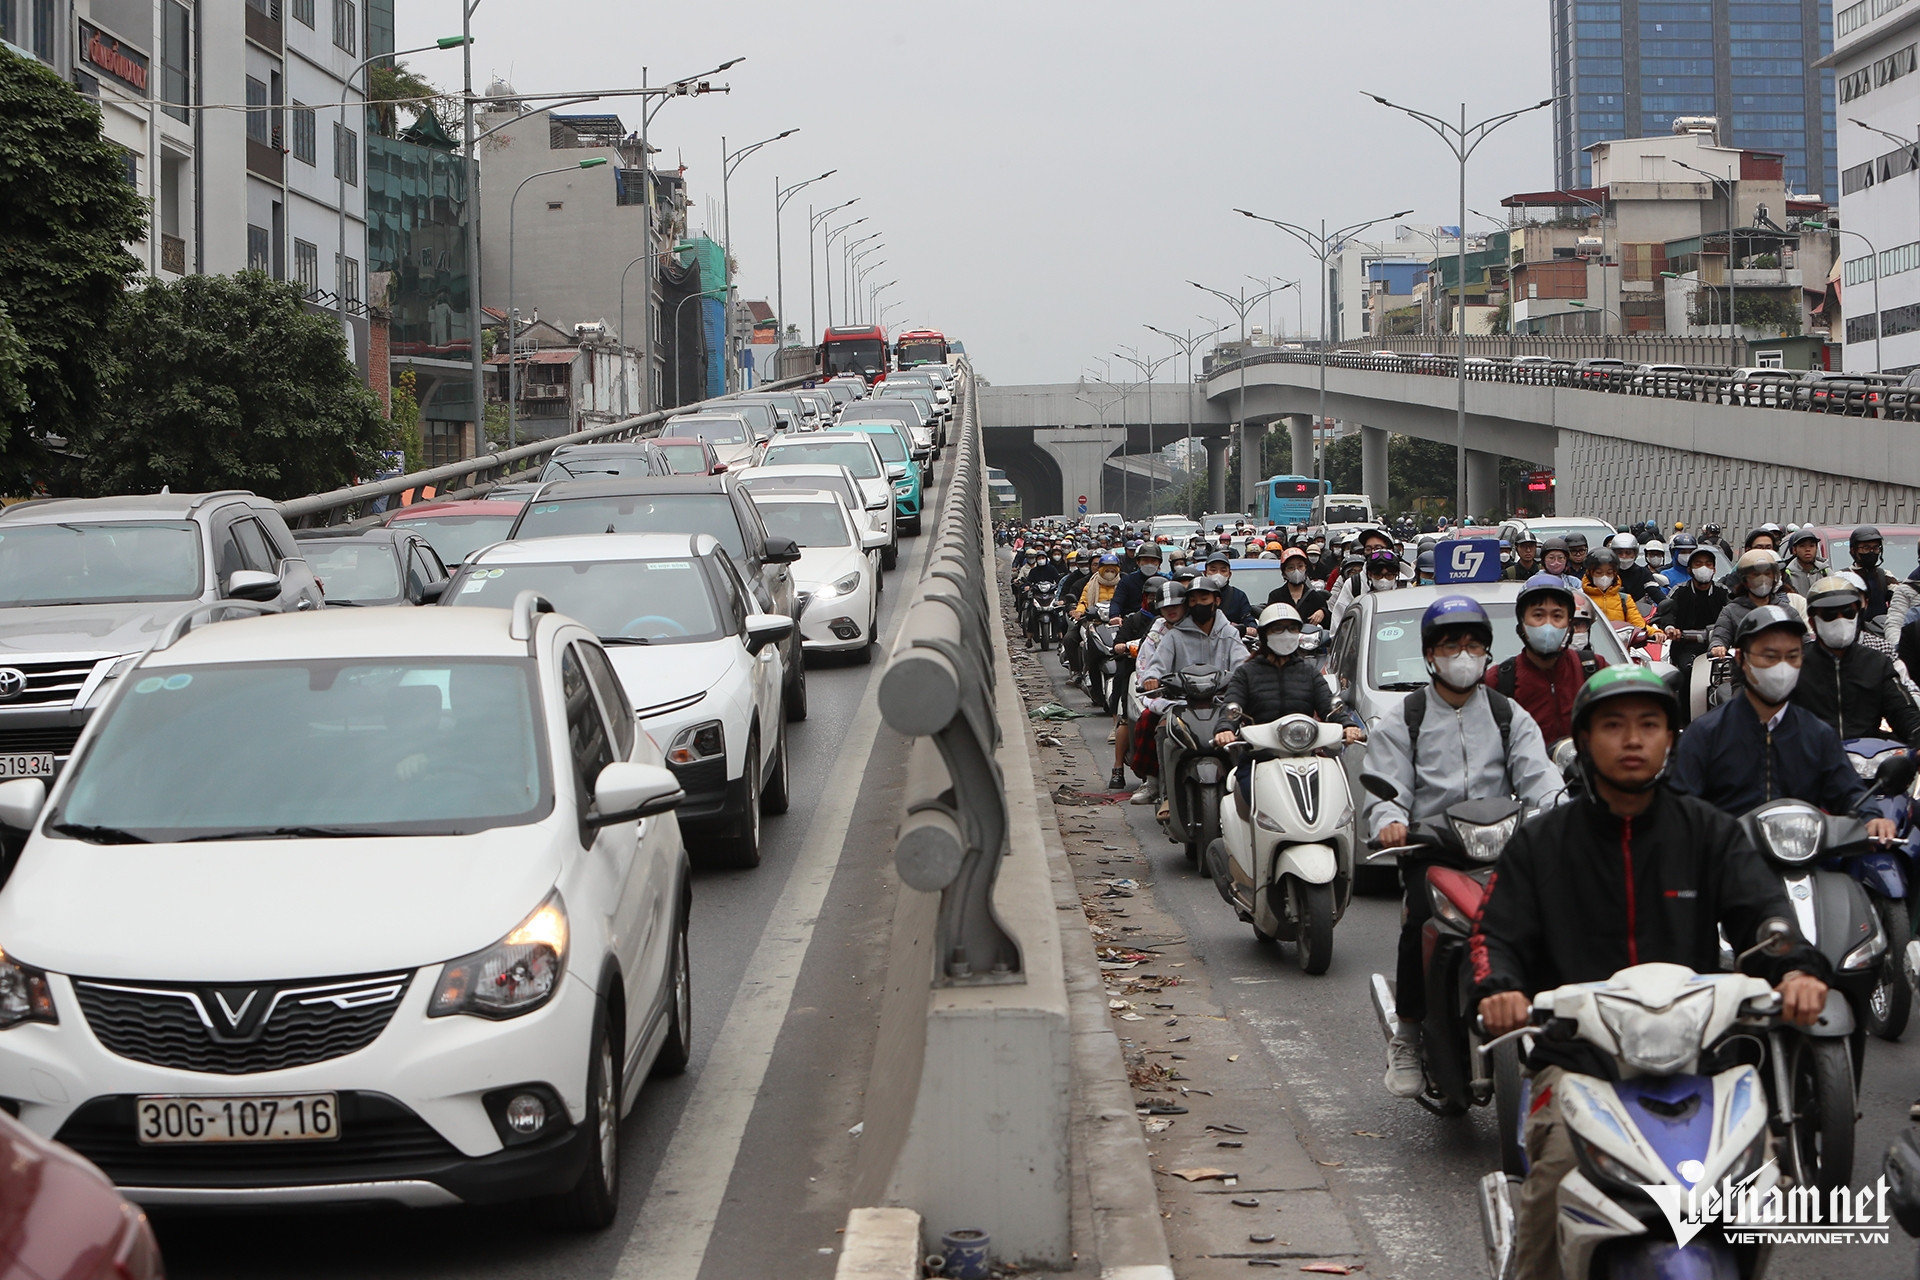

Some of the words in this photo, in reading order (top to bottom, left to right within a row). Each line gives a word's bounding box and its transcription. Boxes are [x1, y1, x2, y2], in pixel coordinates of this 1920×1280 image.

[1451, 544, 1485, 578] G7
[1449, 571, 1468, 579] TAXI
[1381, 629, 1399, 637] 185
[143, 1099, 331, 1138] 30G-107.16
